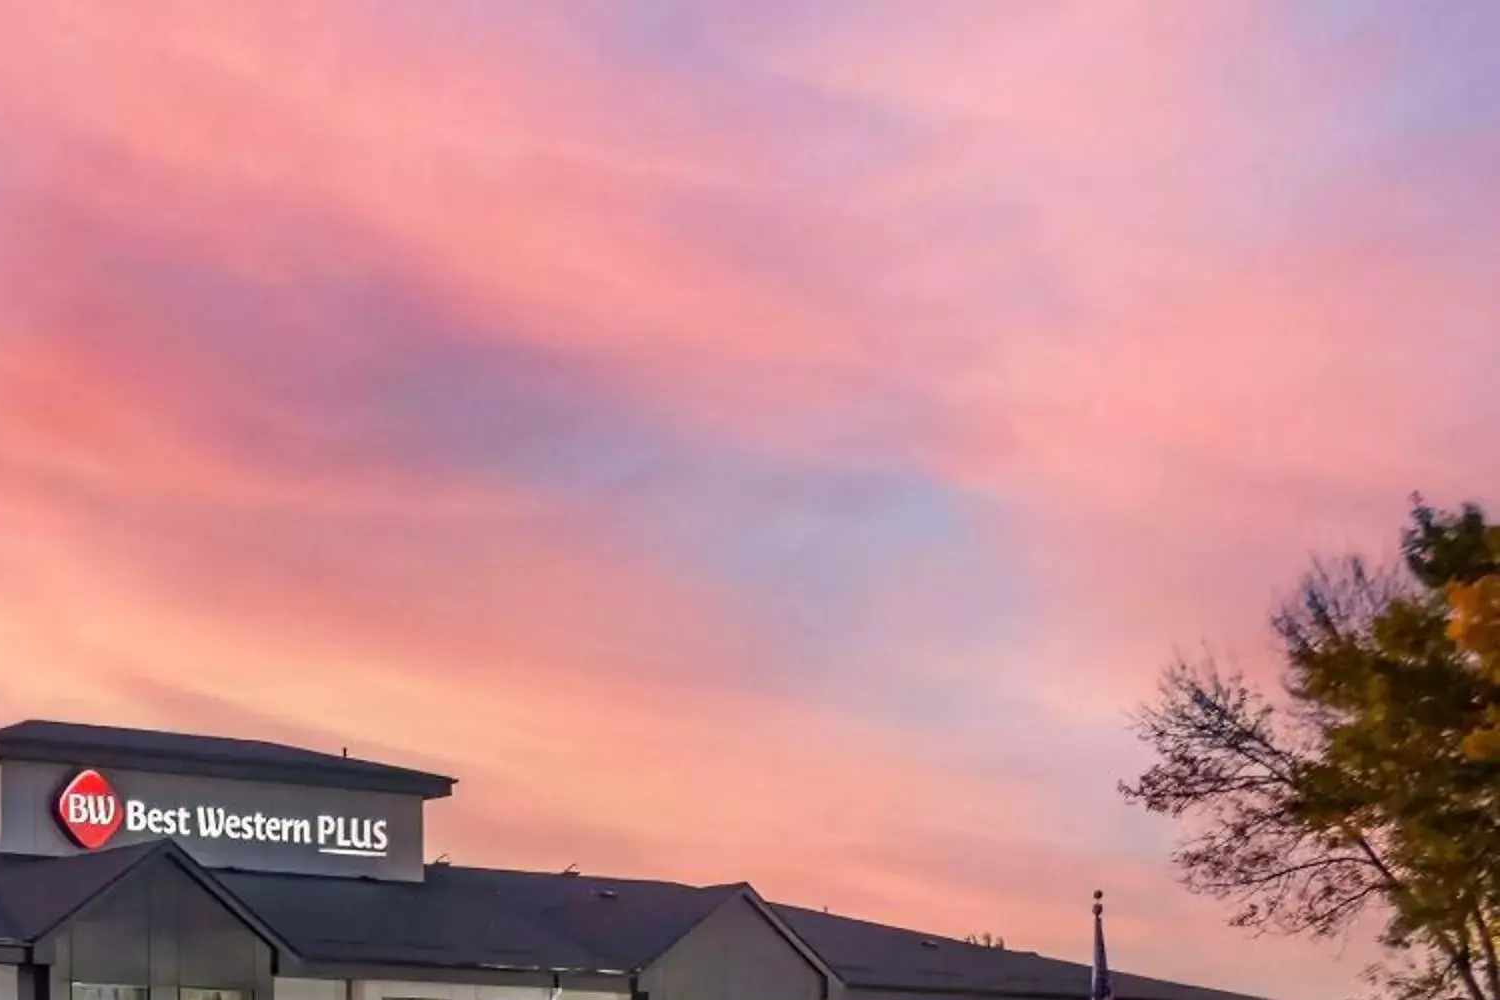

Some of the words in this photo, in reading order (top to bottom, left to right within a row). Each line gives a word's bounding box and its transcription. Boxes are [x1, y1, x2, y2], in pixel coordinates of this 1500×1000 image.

[69, 793, 115, 825] BW
[126, 800, 191, 835] Best
[196, 806, 312, 844] Western
[317, 815, 388, 850] PLUS
